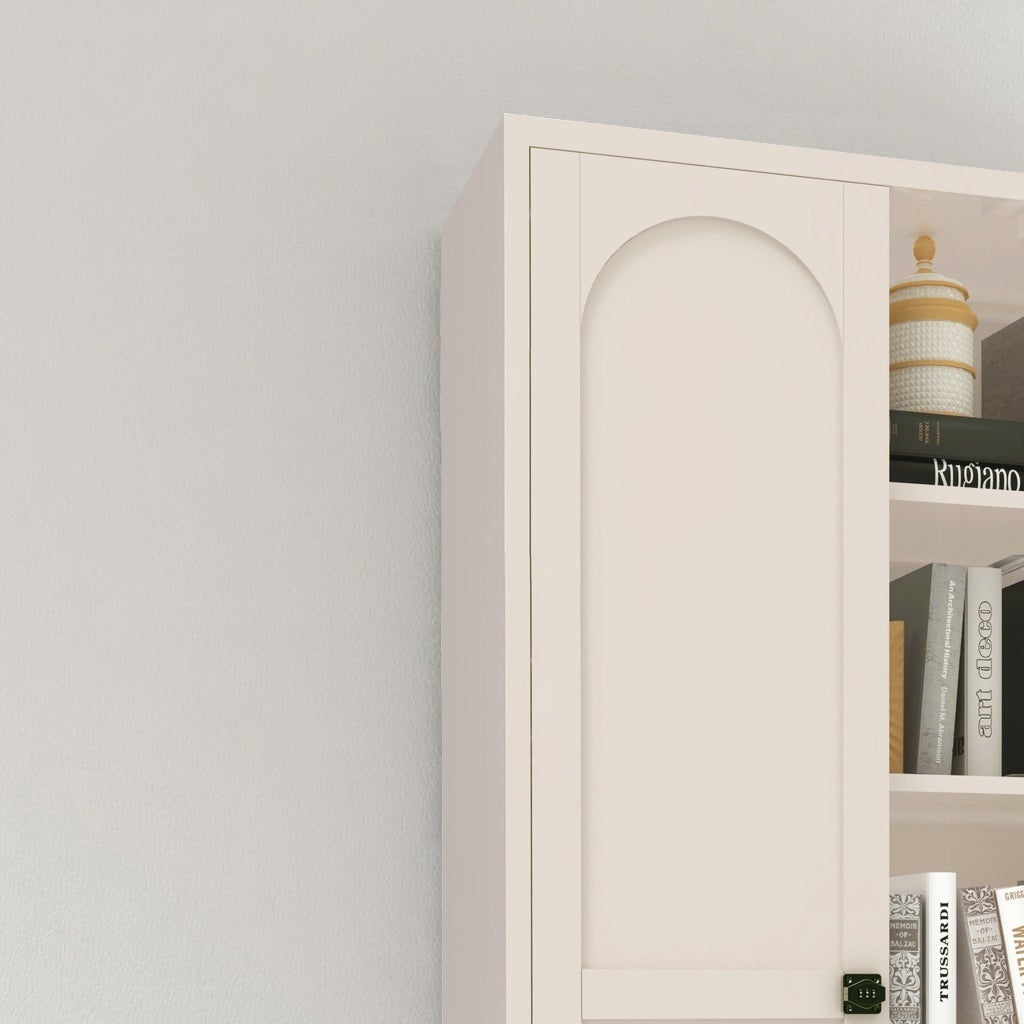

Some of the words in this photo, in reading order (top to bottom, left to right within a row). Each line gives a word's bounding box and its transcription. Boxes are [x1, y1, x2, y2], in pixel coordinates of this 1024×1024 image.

[949, 580, 956, 592] An
[944, 593, 955, 649] Architectural
[975, 601, 993, 679] deco
[941, 648, 951, 679] History
[940, 686, 948, 711] Daniel
[976, 688, 992, 738] art
[1004, 890, 1024, 901] GRIGG
[889, 922, 918, 930] MEMOIR
[969, 917, 997, 927] MEMOIR
[939, 902, 949, 1003] TRUSSARDI
[972, 935, 999, 945] BALZAC
